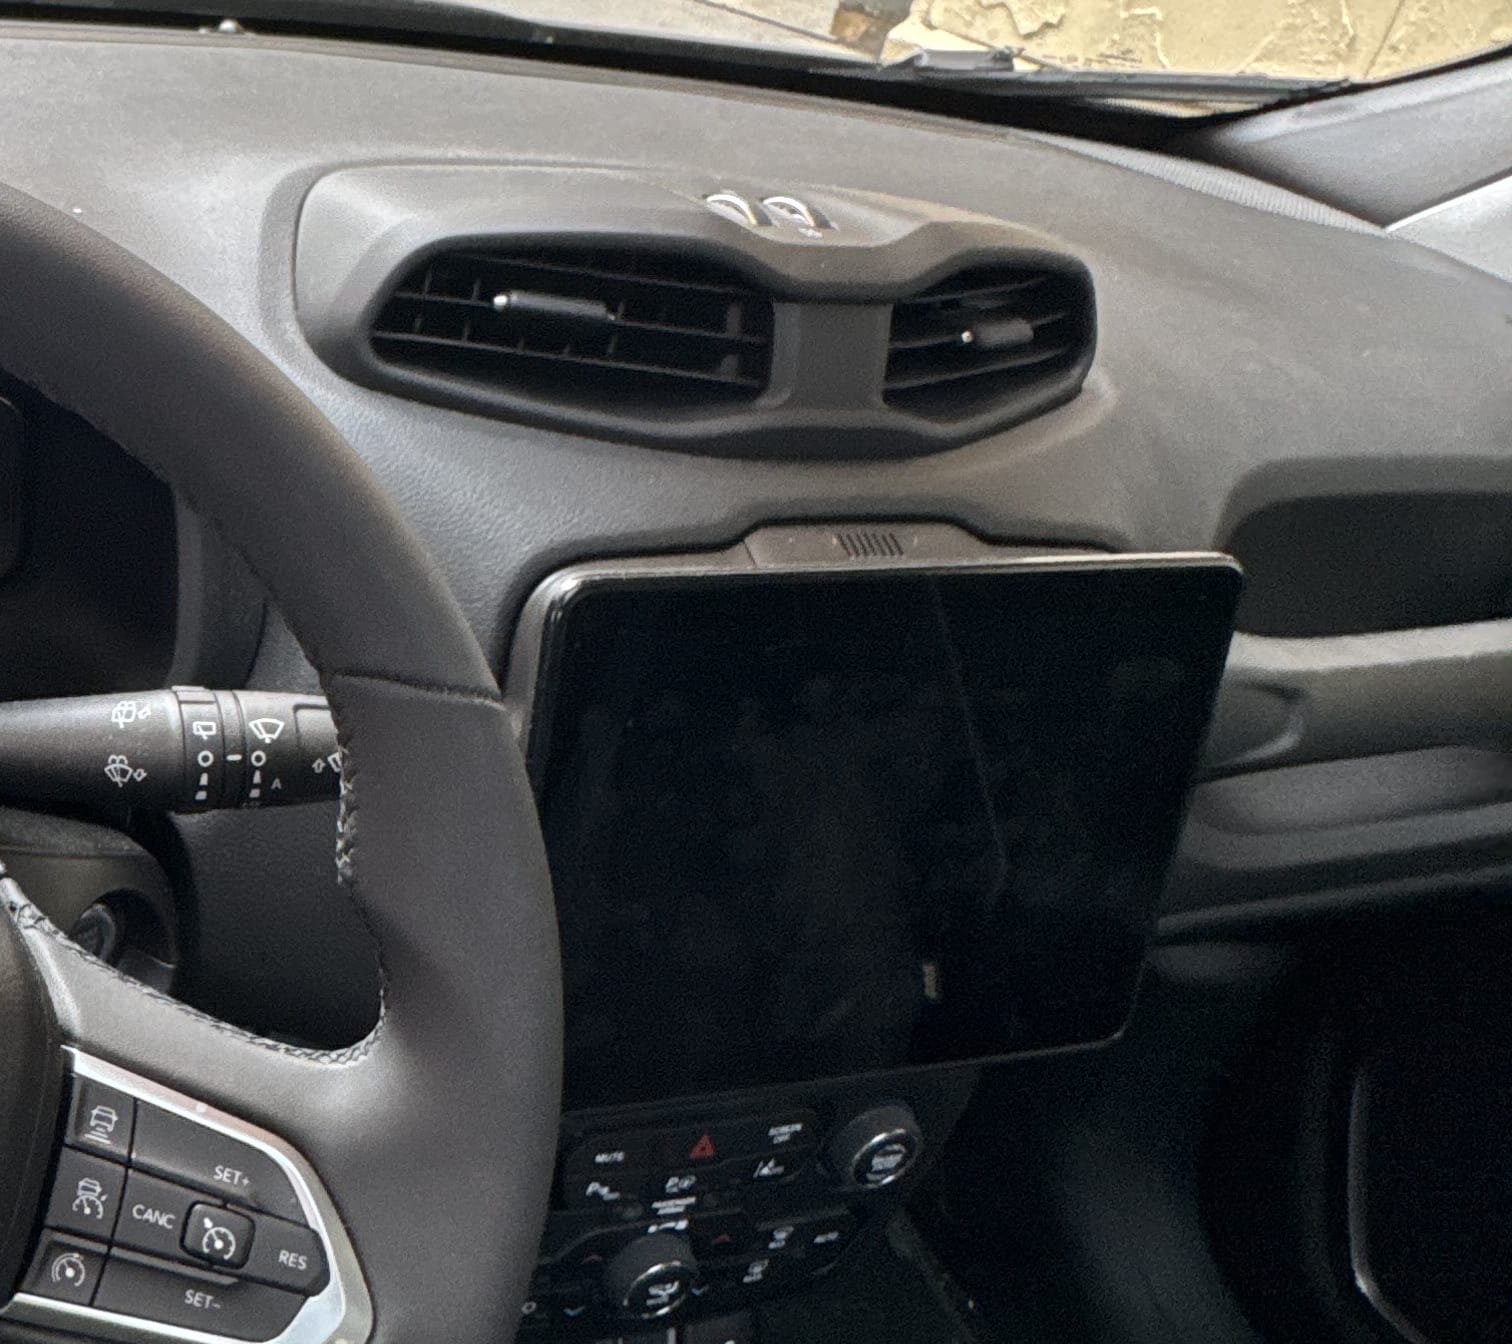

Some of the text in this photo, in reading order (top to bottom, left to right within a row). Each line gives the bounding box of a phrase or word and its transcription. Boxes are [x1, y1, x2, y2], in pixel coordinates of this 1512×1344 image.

[213, 1163, 251, 1187] SET+
[132, 1203, 175, 1230] CANC
[278, 1248, 308, 1271] RES
